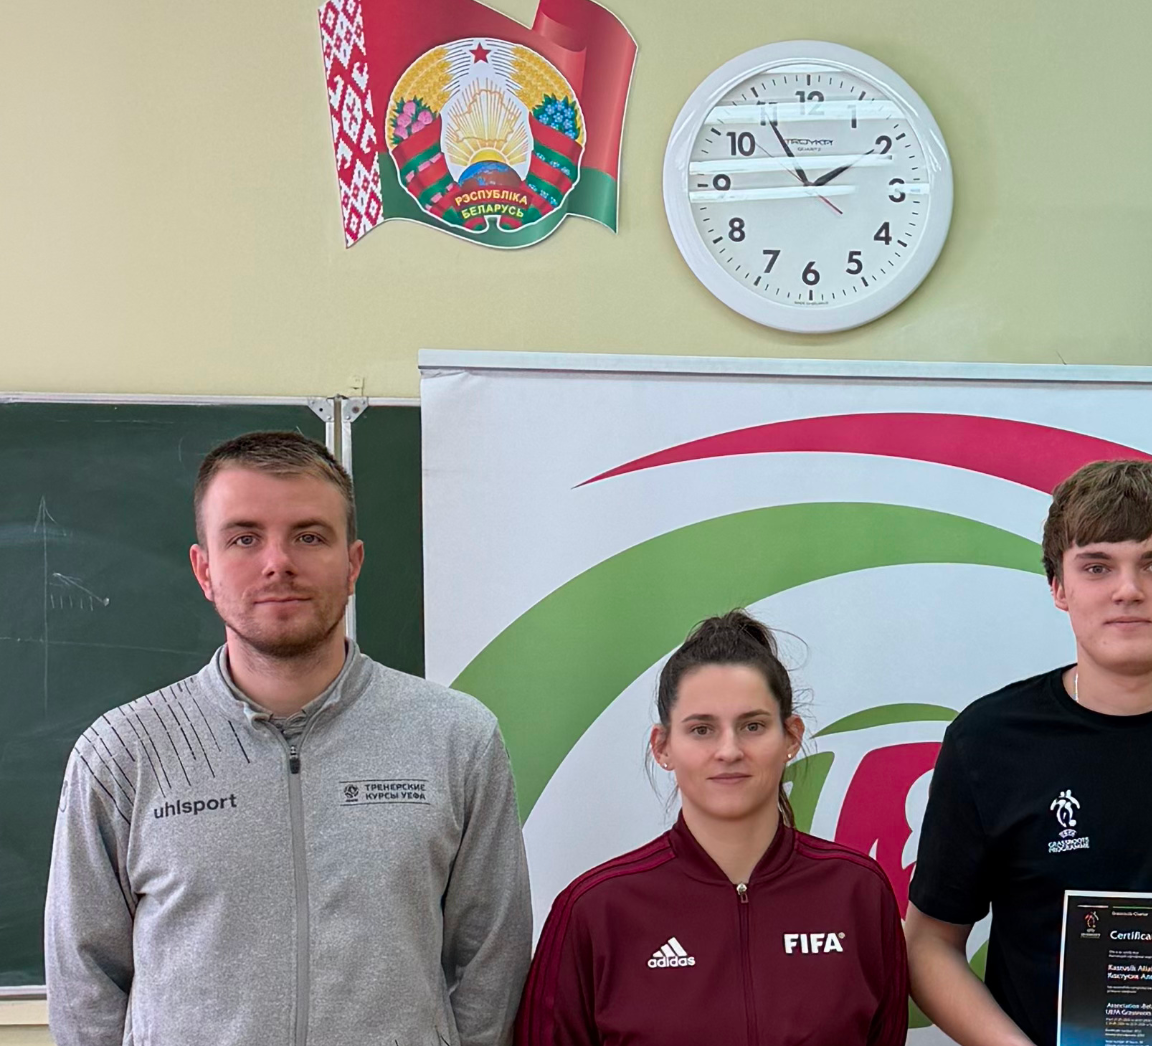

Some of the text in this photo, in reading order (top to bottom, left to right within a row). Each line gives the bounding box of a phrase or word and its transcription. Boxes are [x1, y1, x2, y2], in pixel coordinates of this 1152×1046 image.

[794, 90, 825, 116] 12
[726, 131, 756, 157] 10
[874, 135, 893, 160] 2
[455, 189, 529, 207] РЭСПУБЛІКА
[887, 178, 906, 203] 3
[461, 203, 525, 220] БЕЛАРУСЬ
[728, 217, 746, 242] 8
[873, 221, 893, 246] 4
[762, 249, 781, 274] 7
[801, 261, 821, 286] 6
[845, 250, 863, 275] 5
[364, 783, 426, 792] ТРЕНЕРСКИЕ
[366, 791, 426, 801] КУРСЫ УЕФА
[153, 793, 237, 819] uhlsport
[647, 956, 696, 968] adidas
